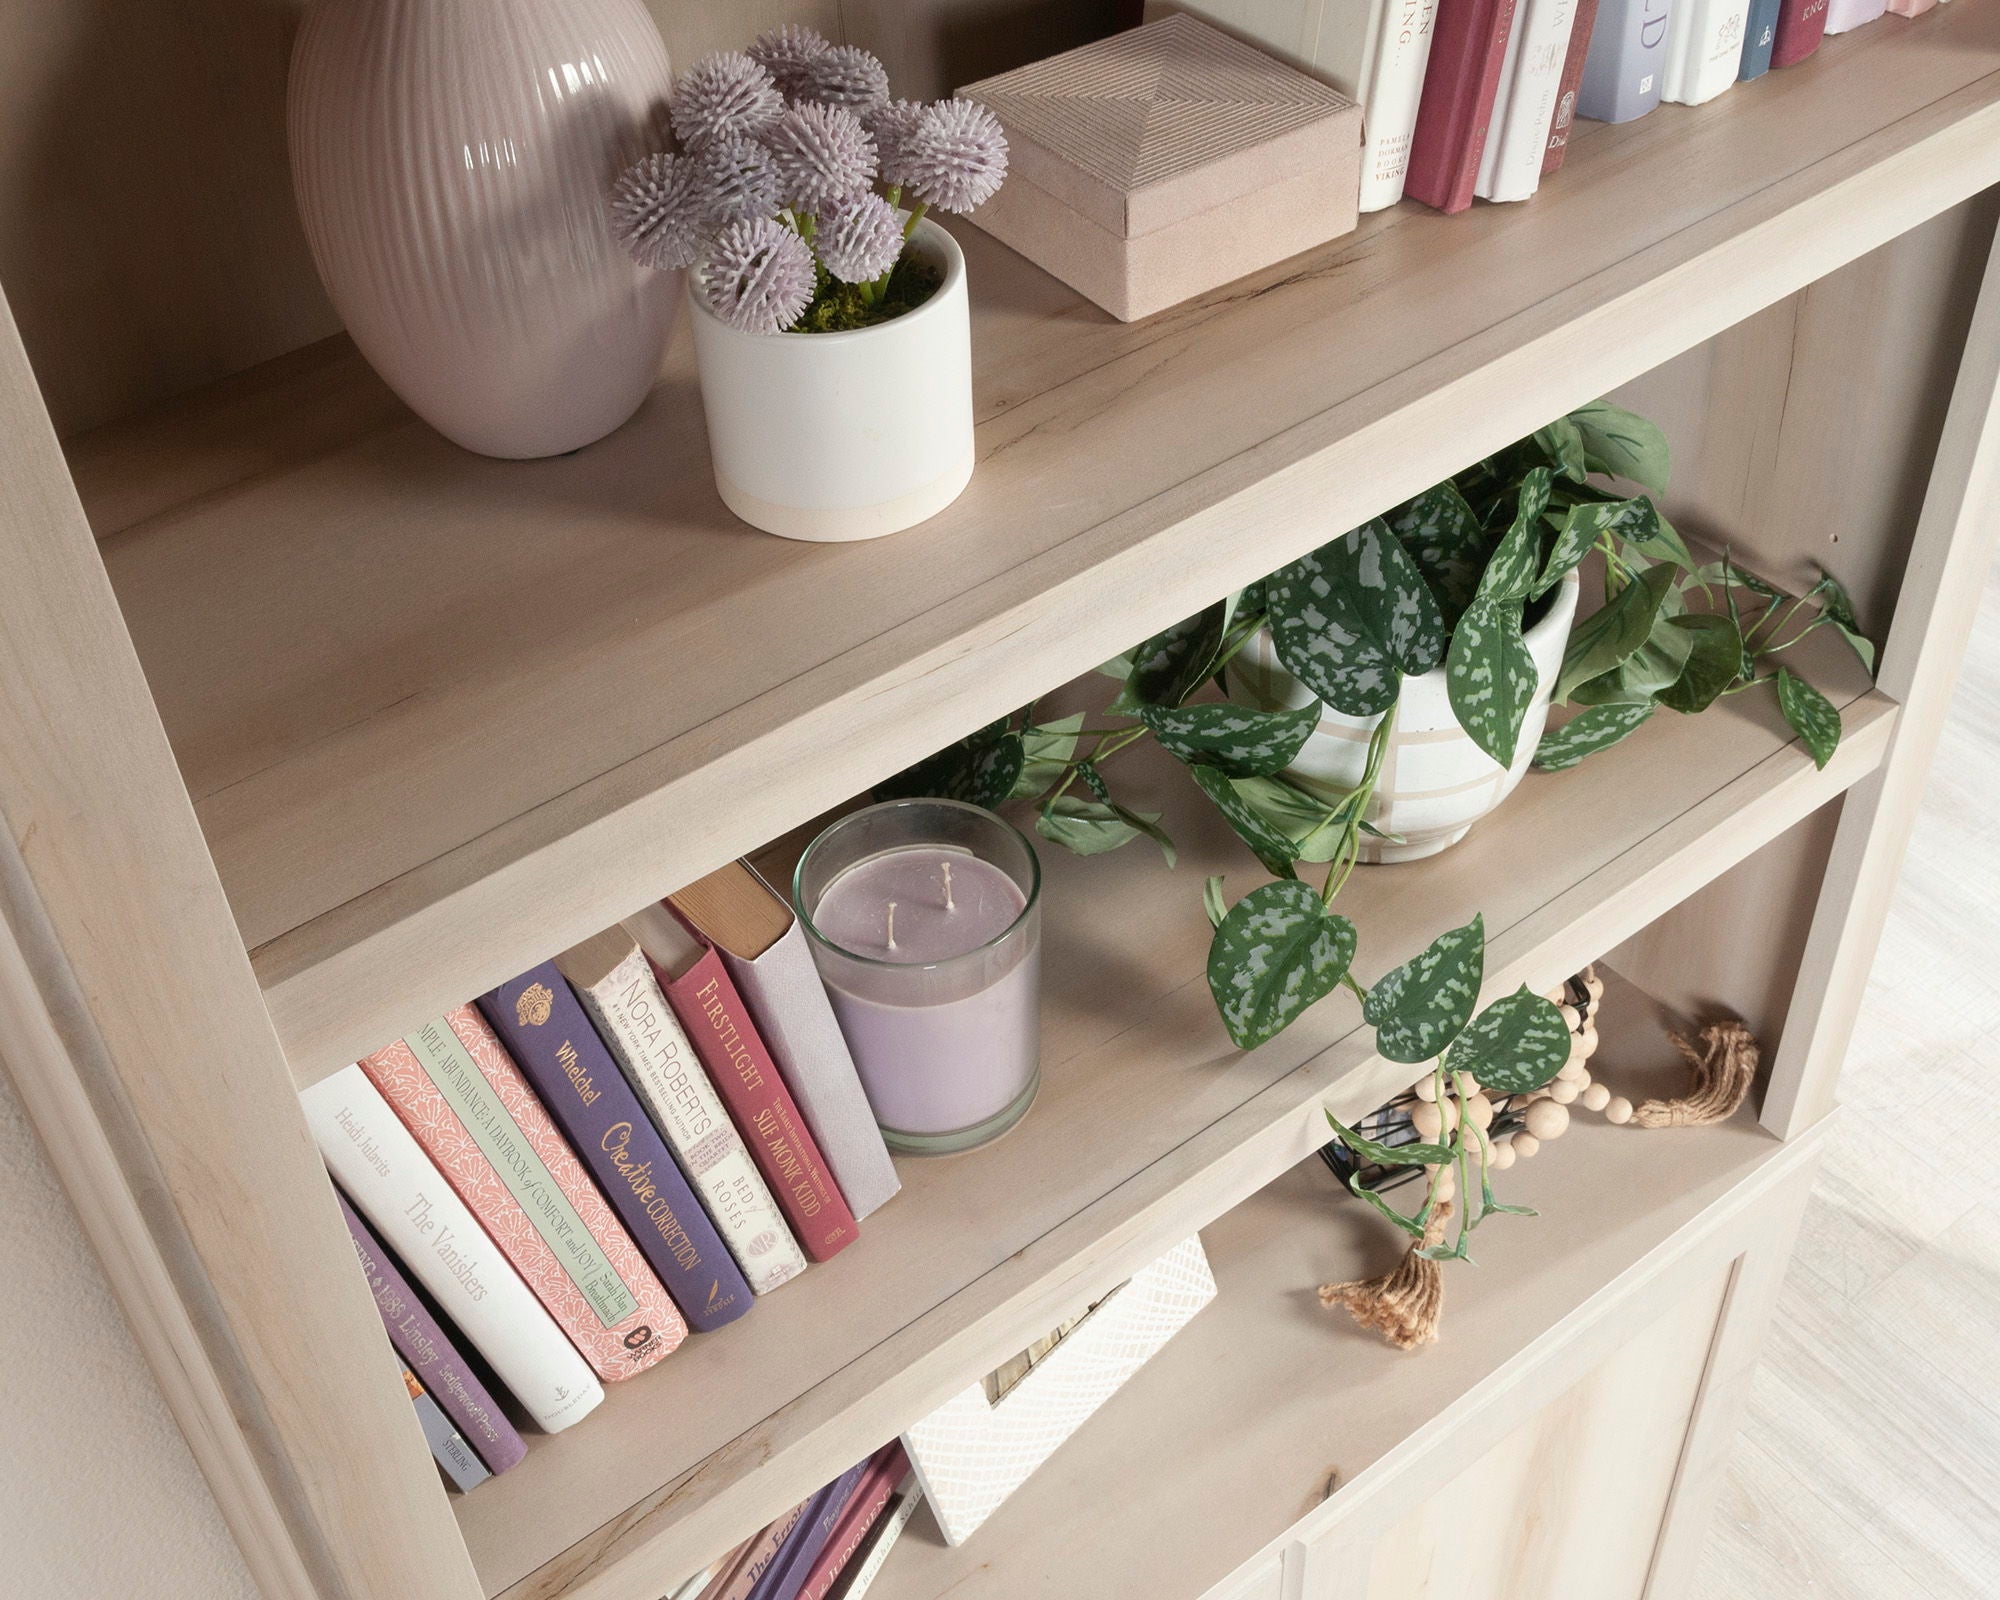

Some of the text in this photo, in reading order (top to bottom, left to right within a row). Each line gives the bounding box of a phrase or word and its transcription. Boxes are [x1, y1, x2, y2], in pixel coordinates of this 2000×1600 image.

[1419, 0, 1434, 34] EN
[1802, 0, 1827, 21] KNO
[1375, 167, 1405, 182] VIKING
[695, 977, 764, 1092] FIRSTLIGHT
[554, 1039, 602, 1108] Whelchel
[611, 1003, 691, 1141] #1 NEW YORK TIMES BESTSELLING AUTHOR
[620, 978, 712, 1136] NORA ROBERTS
[334, 1106, 391, 1178] Heidi Julavits
[481, 1116, 496, 1131] A
[489, 1126, 533, 1182] DAYBOOK
[690, 1130, 728, 1160] BOOK TWO
[699, 1143, 729, 1168] QUARTET
[700, 1147, 711, 1160] THE
[752, 1107, 822, 1217] SUE MONK KIDD
[520, 1178, 542, 1192] of
[601, 1121, 702, 1273] Creative CORRECTION
[712, 1179, 747, 1230] ROSES
[732, 1175, 755, 1204] BED
[532, 1187, 574, 1239] COMFORT
[404, 1192, 488, 1302] The Vanishers
[565, 1239, 586, 1255] and
[572, 1249, 597, 1270] JOY
[585, 1279, 621, 1323] Breathnach
[600, 1271, 628, 1312] Sarah Ban
[626, 1335, 662, 1360] WARNER
[399, 1314, 440, 1366] Linsley
[439, 1363, 482, 1418] Sedgewood
[476, 1410, 499, 1443] Press
[544, 1384, 590, 1421] DOUBLEDAY
[442, 1439, 472, 1472] STERLING
[747, 1505, 802, 1583] The Error
